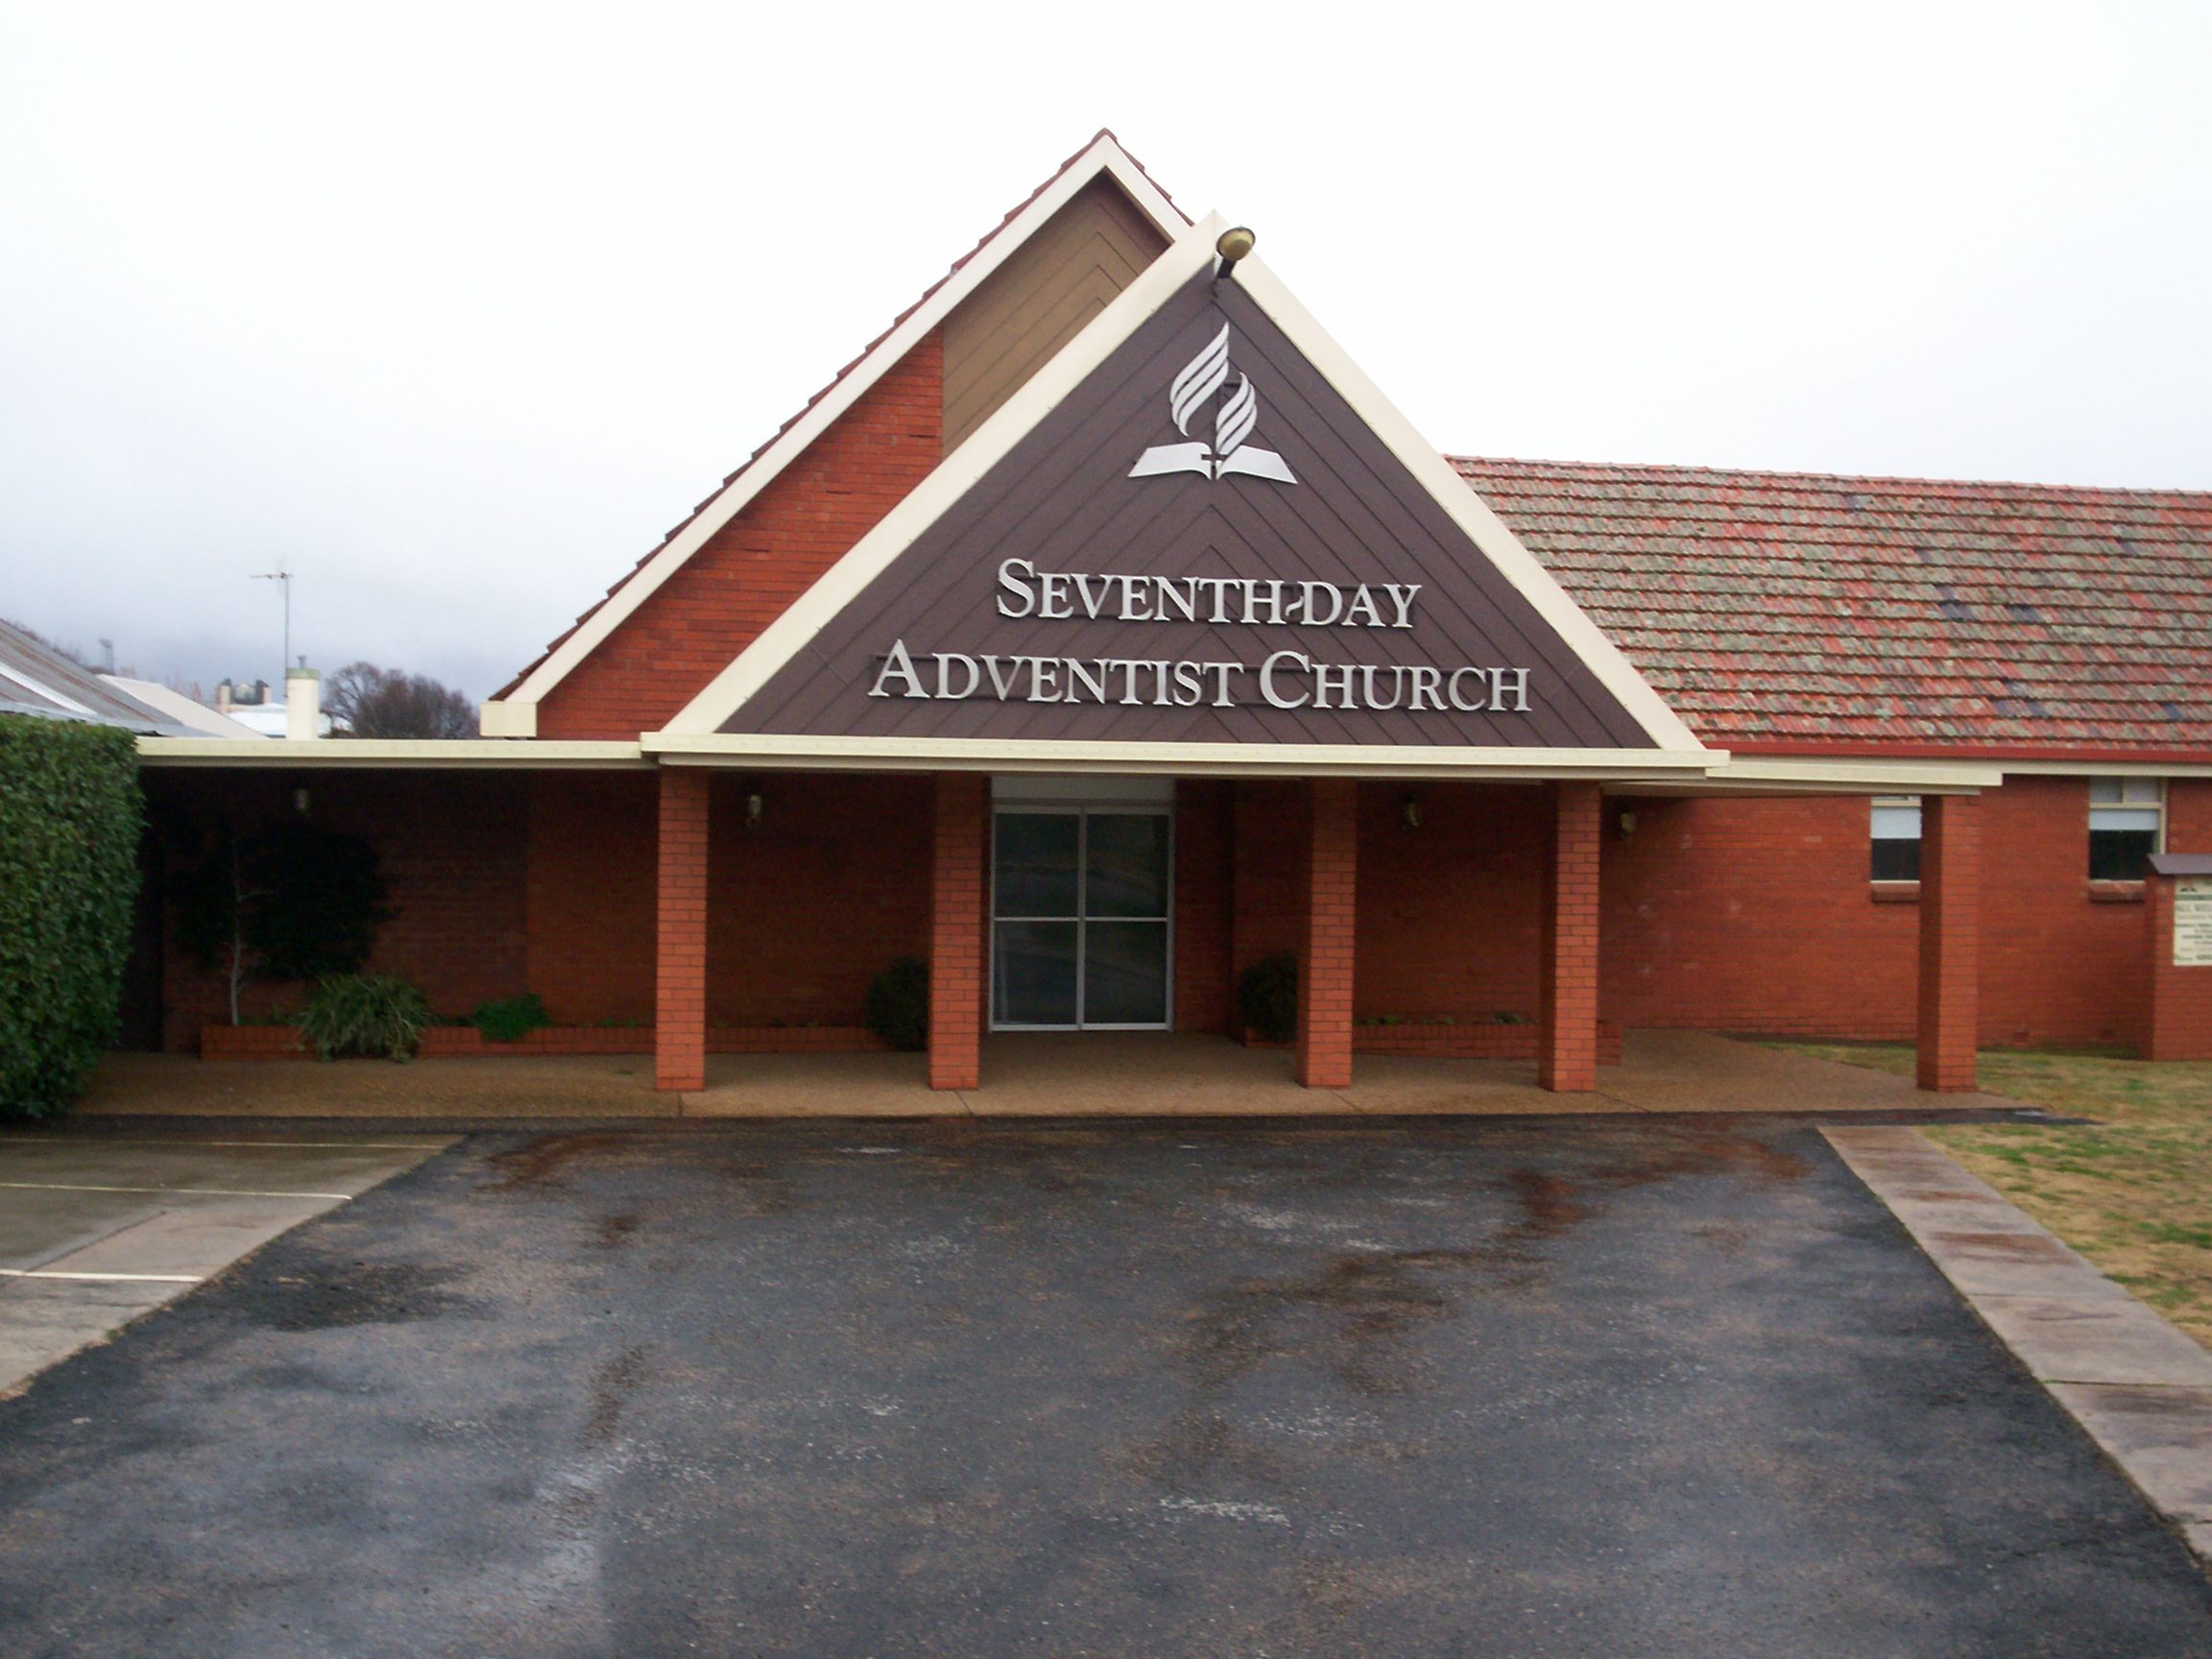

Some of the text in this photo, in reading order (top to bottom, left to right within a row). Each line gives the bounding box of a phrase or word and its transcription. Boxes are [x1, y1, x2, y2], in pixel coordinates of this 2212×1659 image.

[997, 558, 1422, 629] SEVENTH-DAY
[868, 638, 1532, 711] ADVENTIST CHURCH
